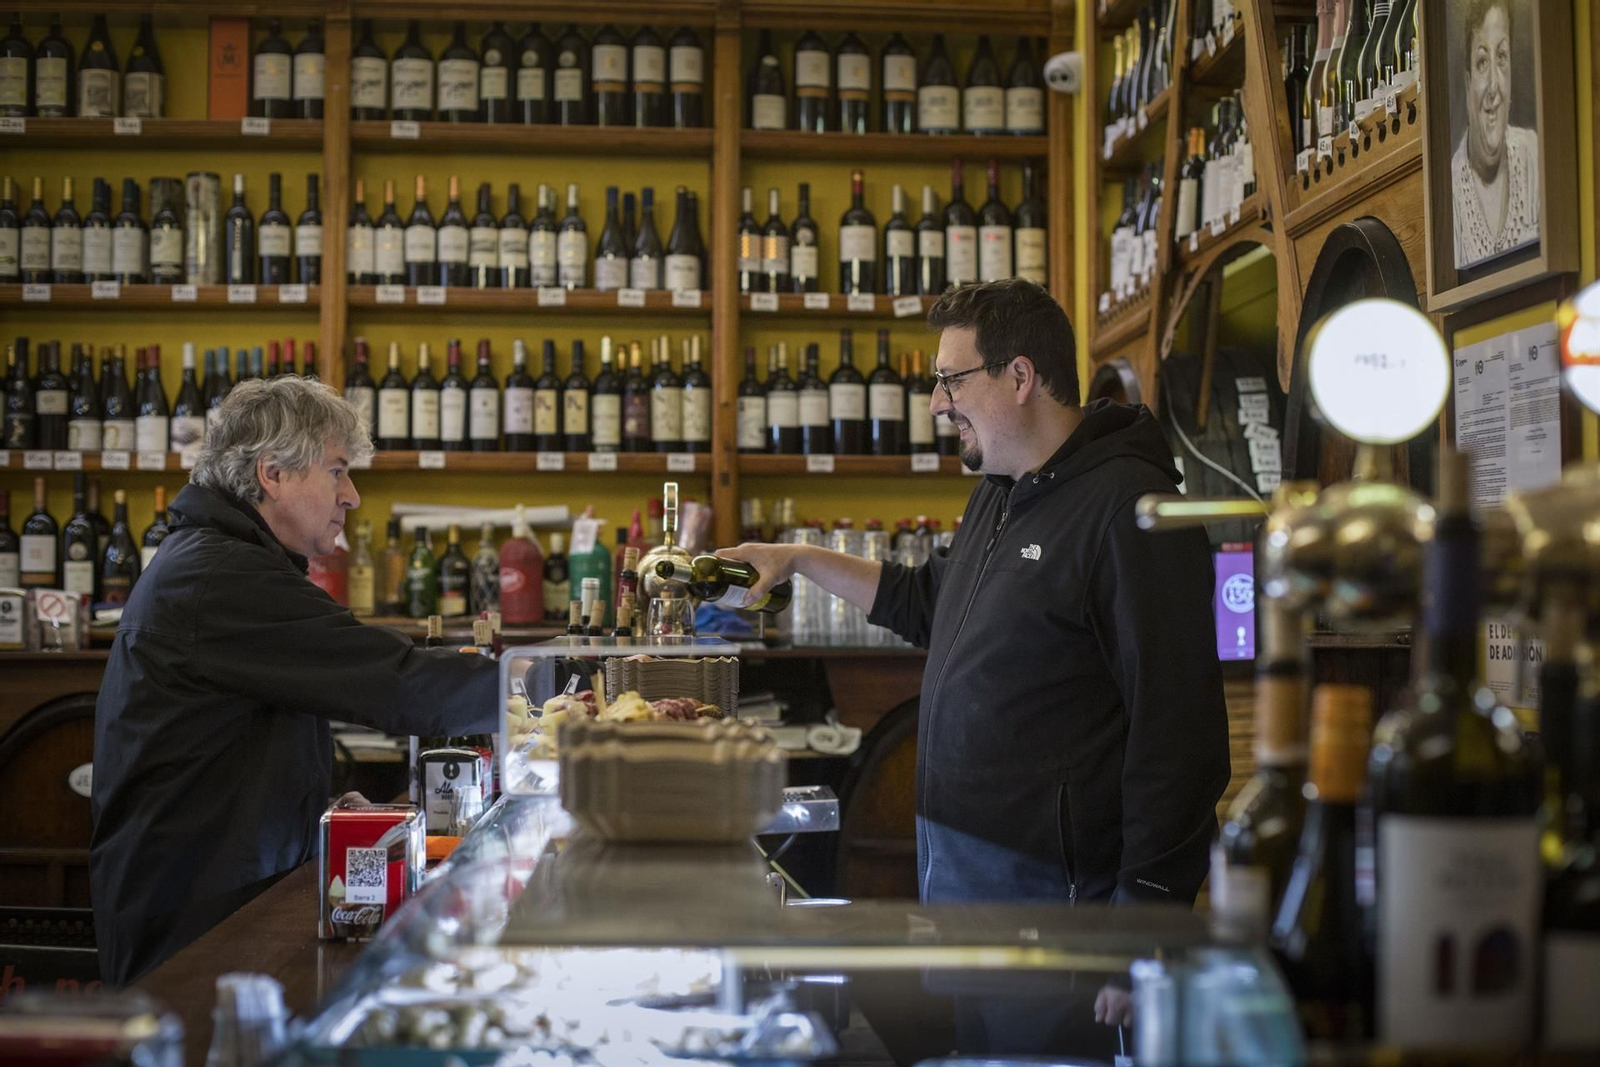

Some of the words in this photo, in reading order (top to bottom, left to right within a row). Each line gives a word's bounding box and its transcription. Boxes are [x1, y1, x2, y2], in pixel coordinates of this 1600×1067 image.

[1490, 645, 1499, 660] DE
[1136, 879, 1170, 891] WINDWALL
[332, 906, 382, 925] Coca-Cola
